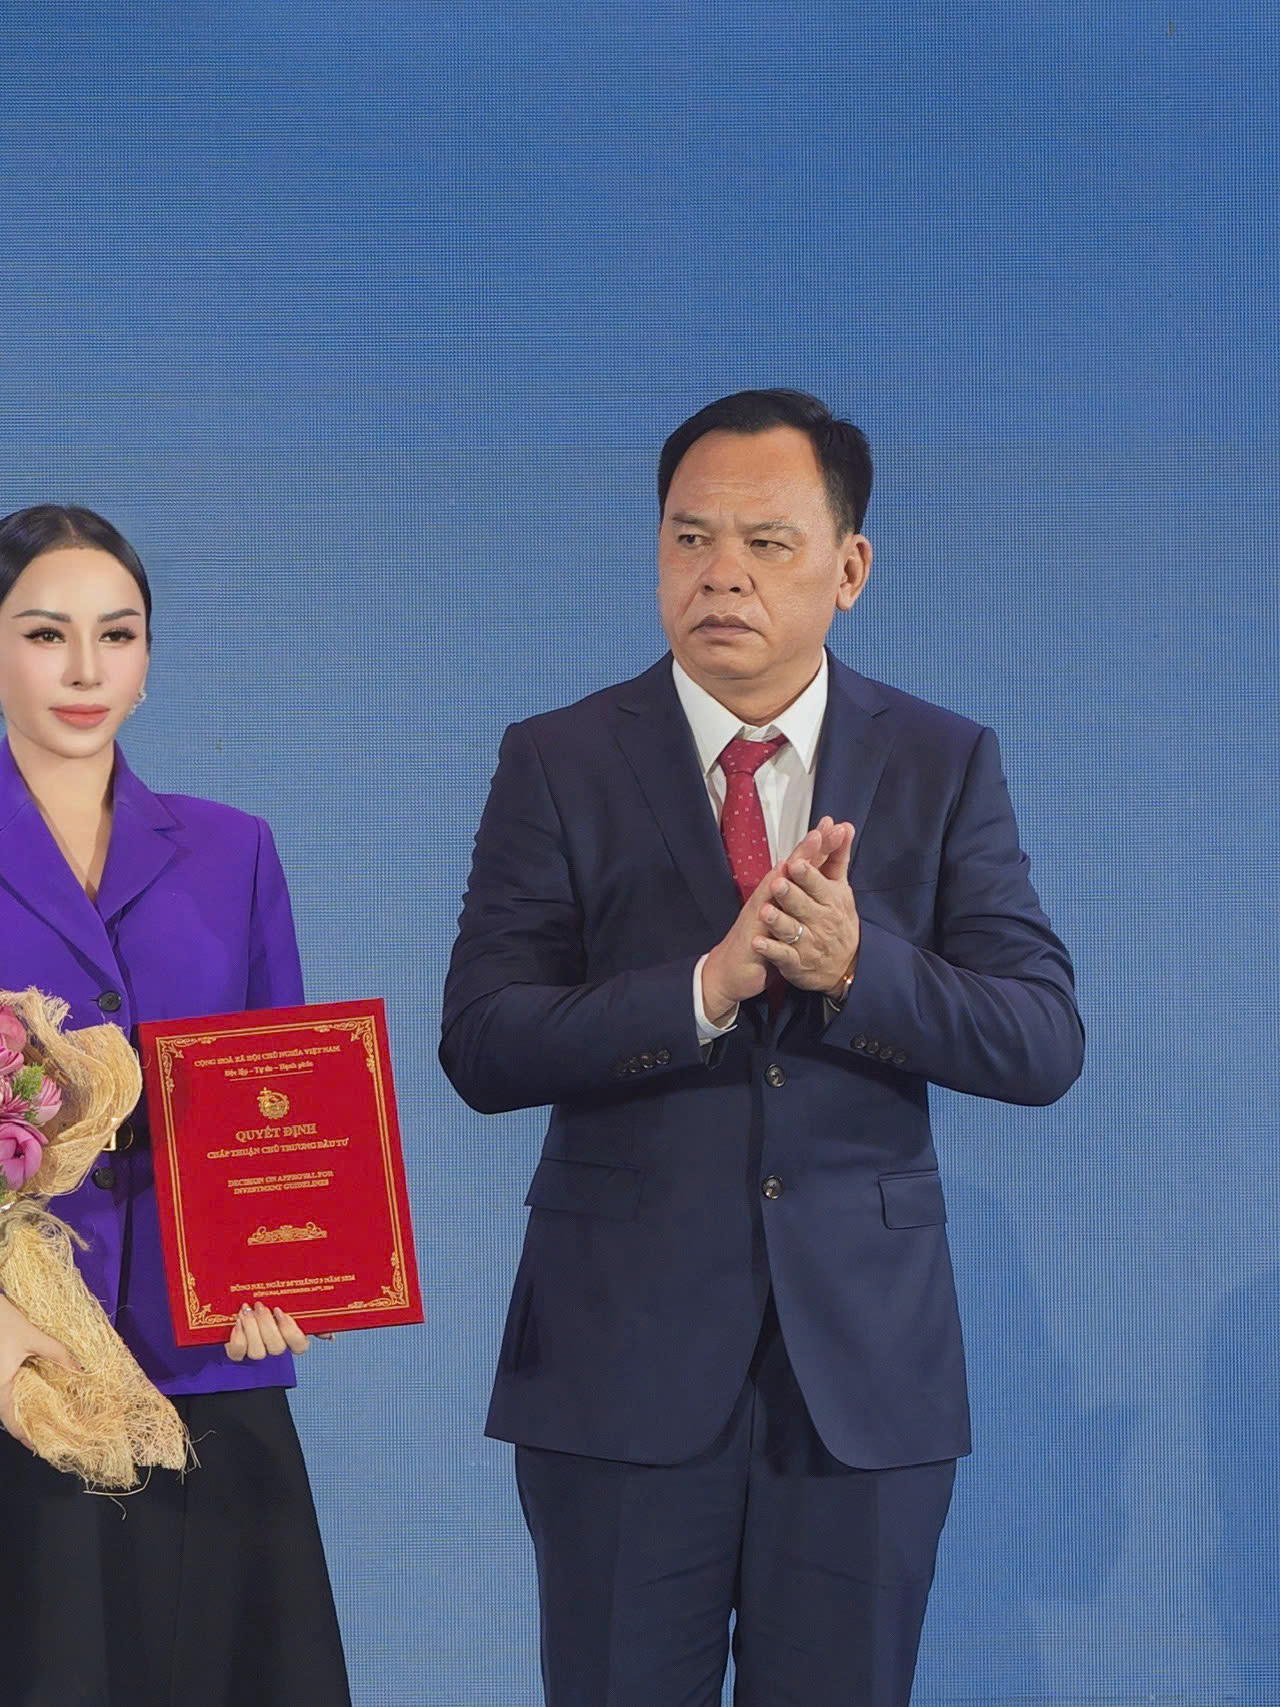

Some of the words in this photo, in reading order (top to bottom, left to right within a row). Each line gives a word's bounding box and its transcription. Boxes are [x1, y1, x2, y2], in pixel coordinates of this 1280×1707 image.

[235, 1124, 281, 1143] QUYẾT
[283, 1123, 318, 1138] ĐỊNH
[227, 1177, 264, 1188] DECISION
[265, 1175, 277, 1183] ON
[233, 1184, 282, 1195] INVESTMENT
[283, 1178, 329, 1191] GUIDELINES
